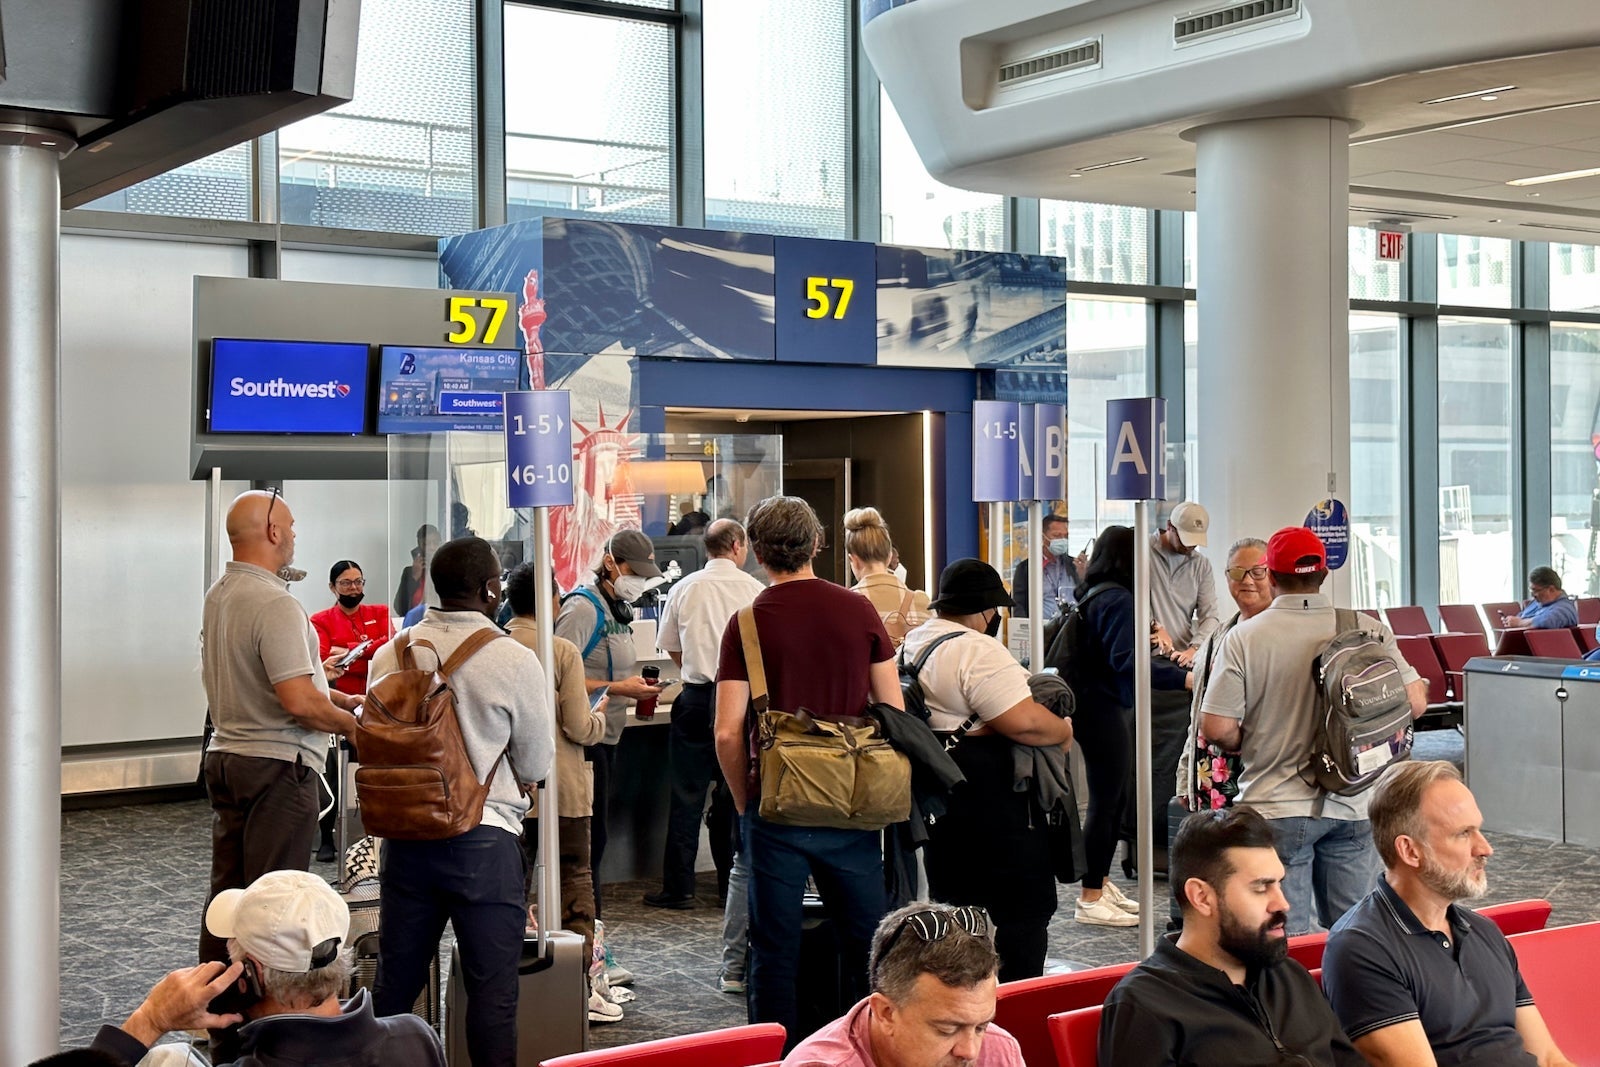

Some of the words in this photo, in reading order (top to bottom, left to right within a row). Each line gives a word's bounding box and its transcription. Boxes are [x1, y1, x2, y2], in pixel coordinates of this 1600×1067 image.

[1380, 232, 1402, 260] EXIT
[807, 276, 854, 320] 57
[447, 297, 508, 344] 57
[460, 353, 495, 364] Kansas
[497, 354, 517, 366] City
[230, 378, 337, 399] Southwest
[452, 399, 496, 408] Southwest
[513, 414, 551, 436] 1-5
[993, 421, 1017, 440] 1-5
[1045, 426, 1063, 477] B
[1110, 421, 1148, 475] A
[522, 464, 569, 486] 6-10
